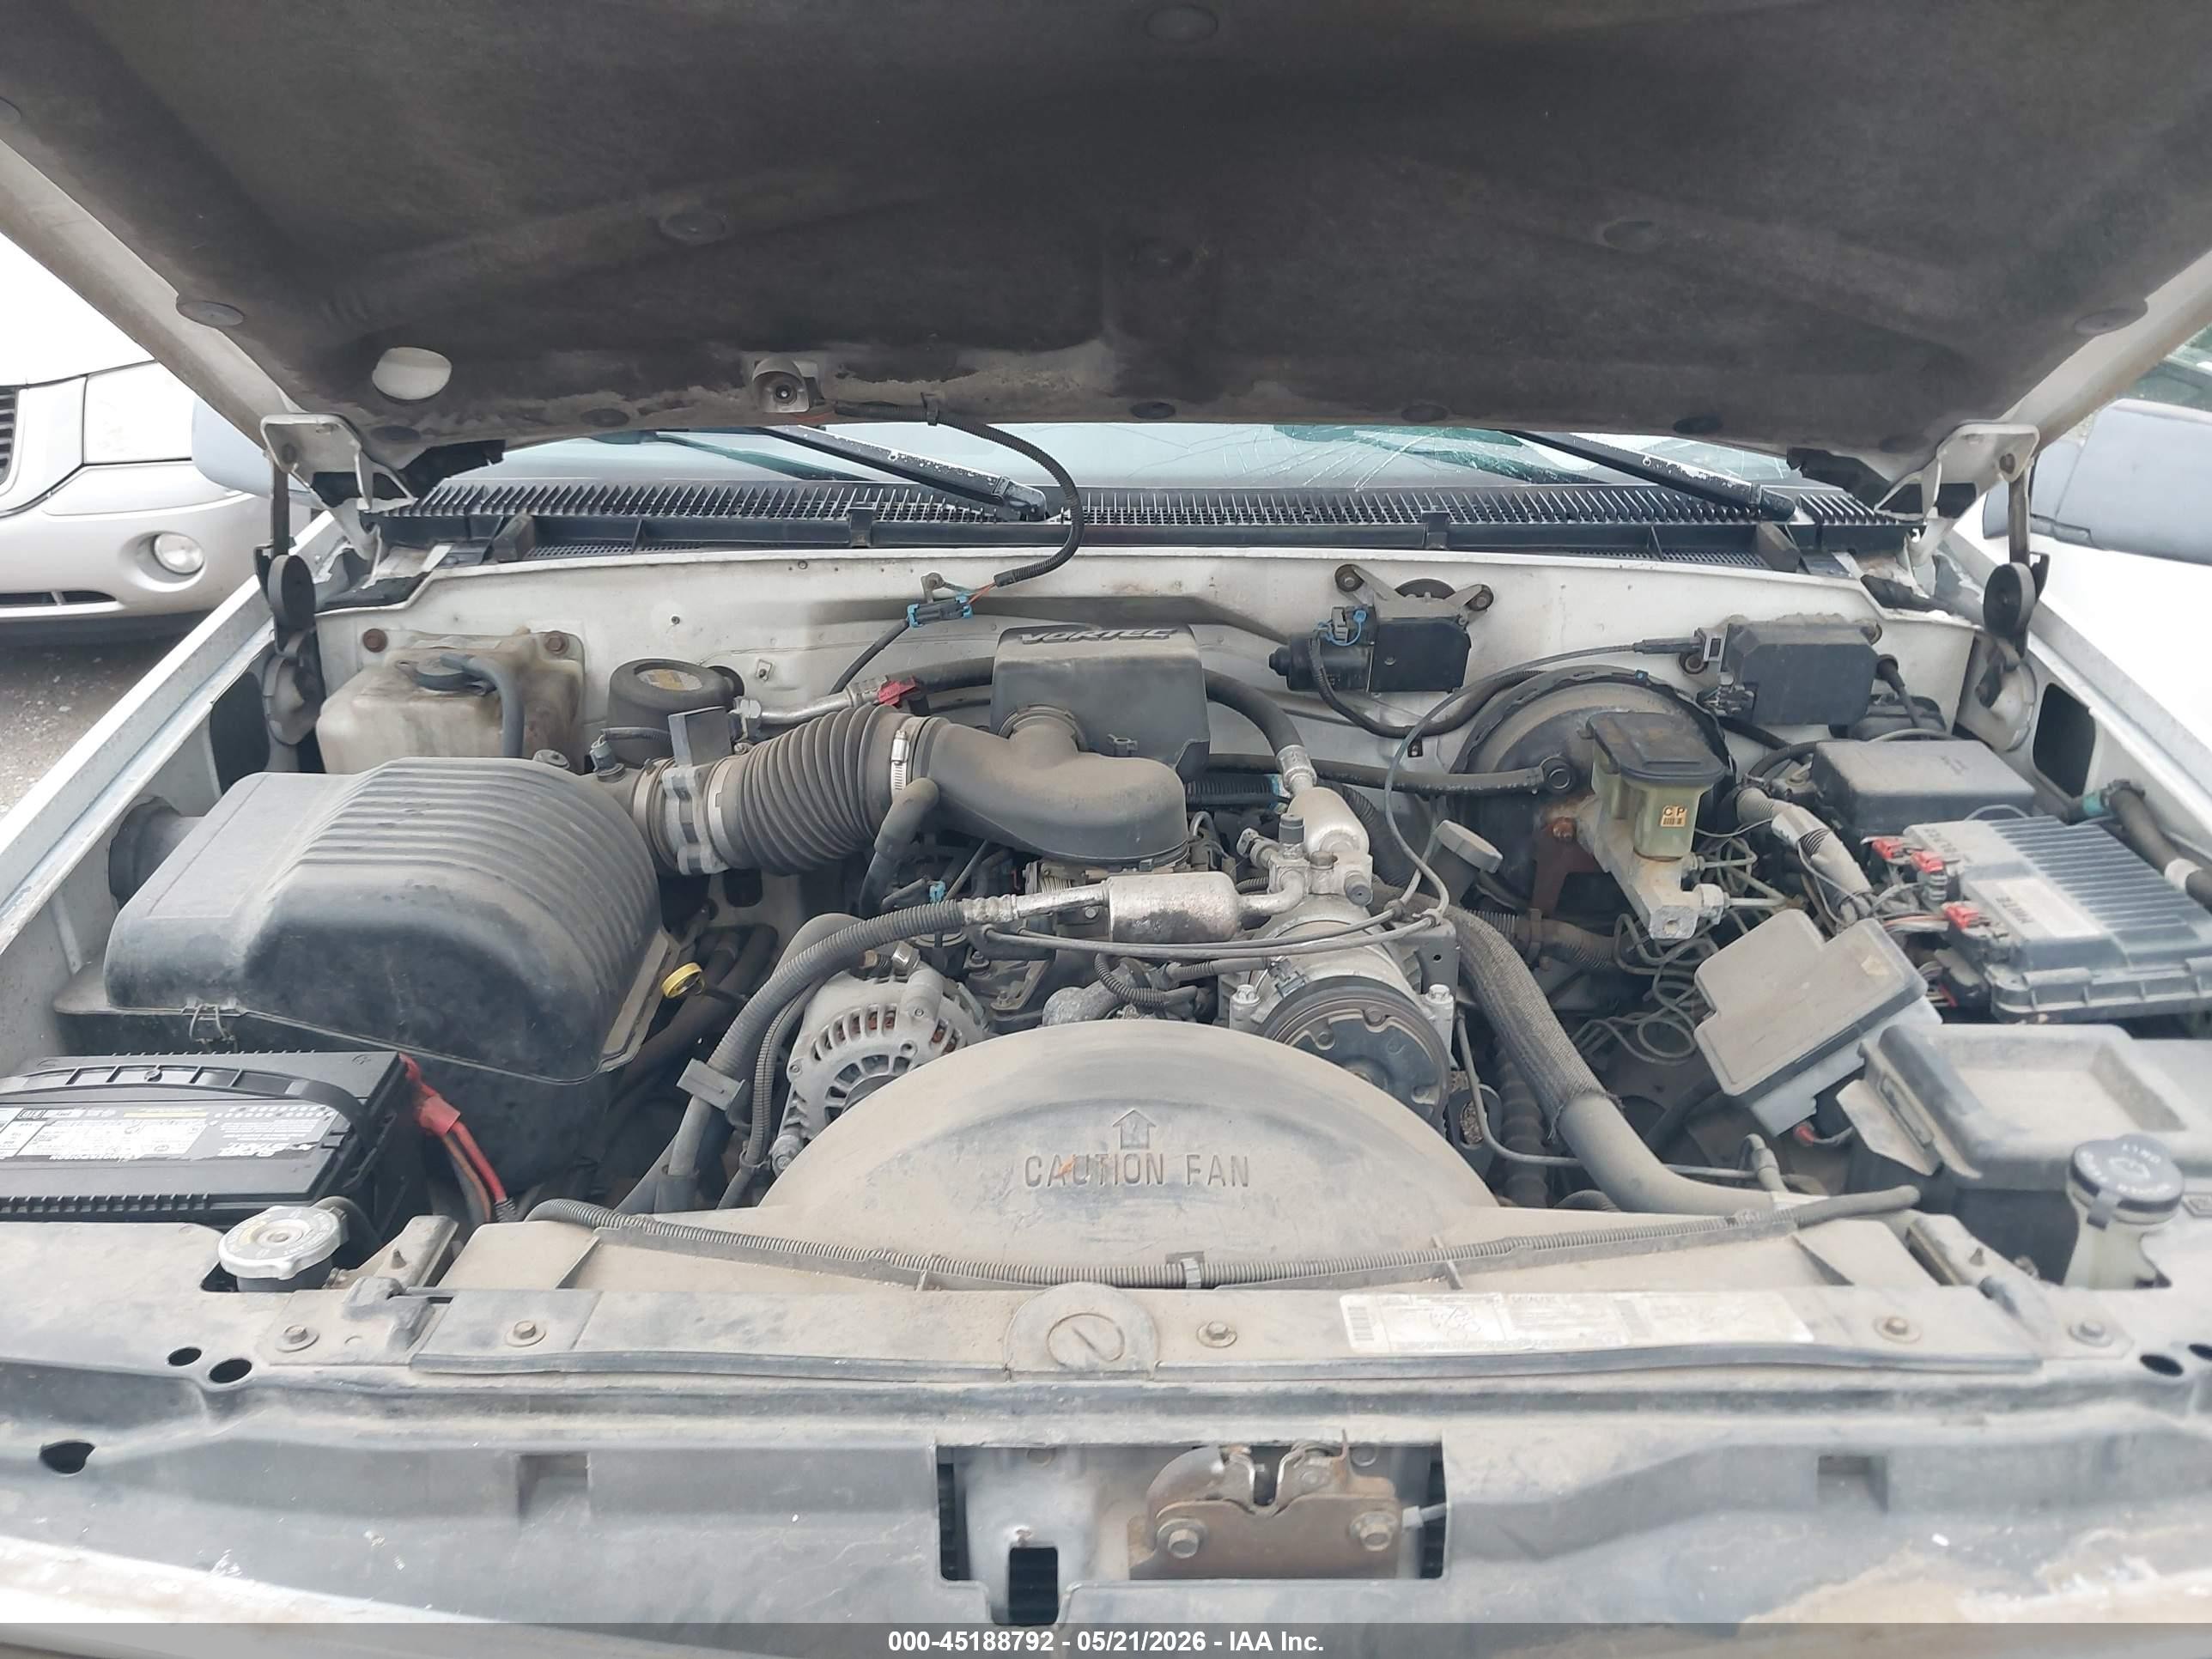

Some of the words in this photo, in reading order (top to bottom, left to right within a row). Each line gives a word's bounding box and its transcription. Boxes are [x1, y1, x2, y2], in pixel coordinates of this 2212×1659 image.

[1020, 629, 1177, 645] VORTEC
[1024, 1153, 1164, 1188] CAUTION
[1186, 1153, 1249, 1188] FAN
